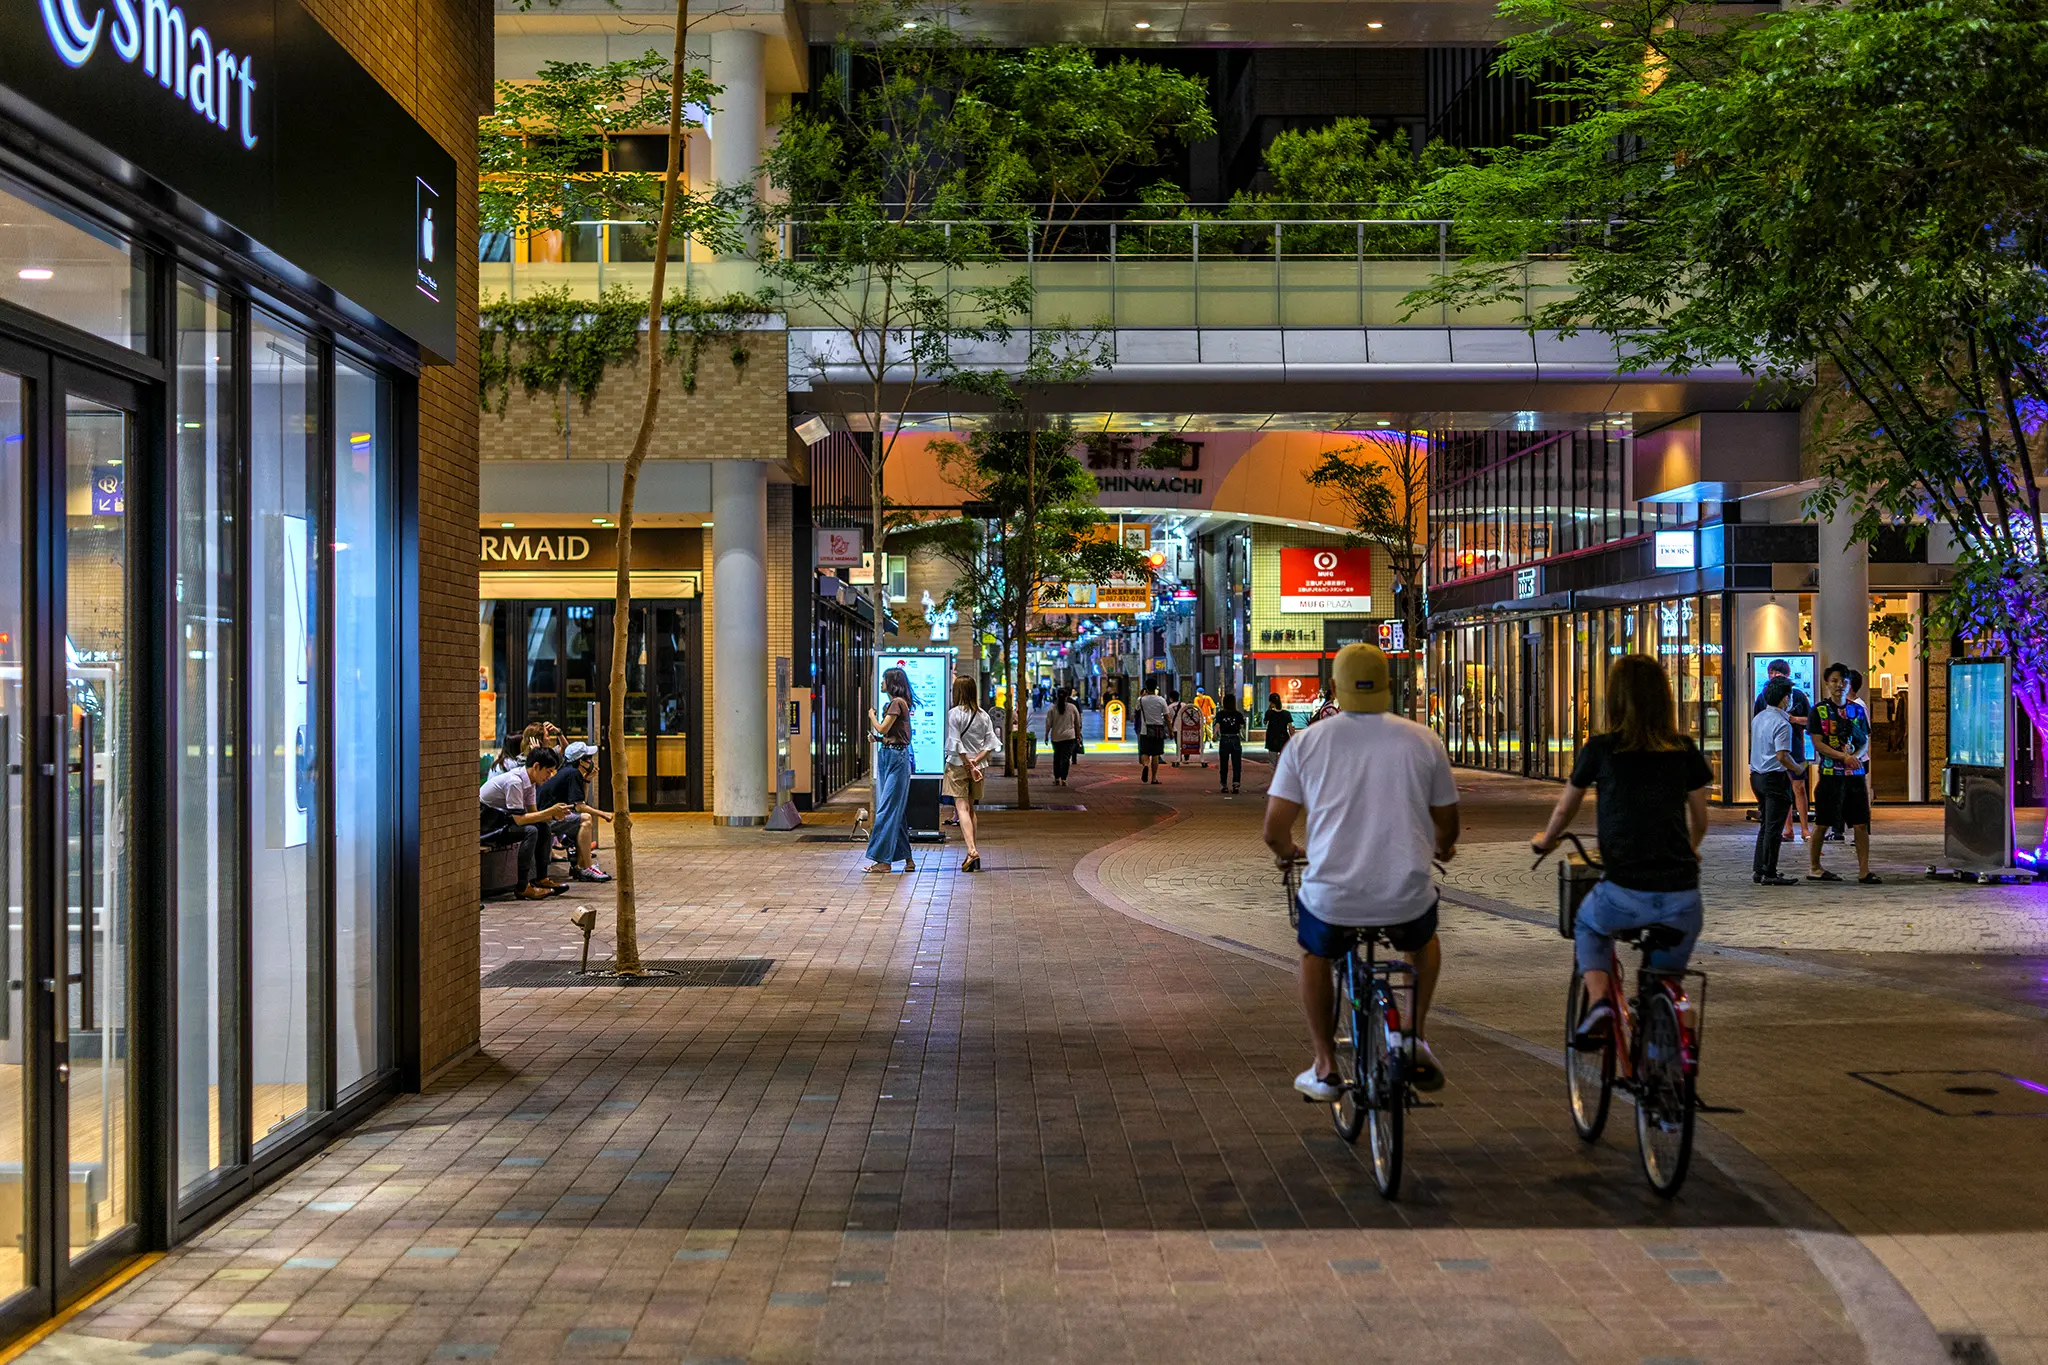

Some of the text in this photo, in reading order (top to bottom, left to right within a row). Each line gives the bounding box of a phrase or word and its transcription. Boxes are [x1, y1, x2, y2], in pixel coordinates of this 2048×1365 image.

[110, 0, 258, 149] smart
[1299, 600, 1353, 608] MUFG PLAZA
